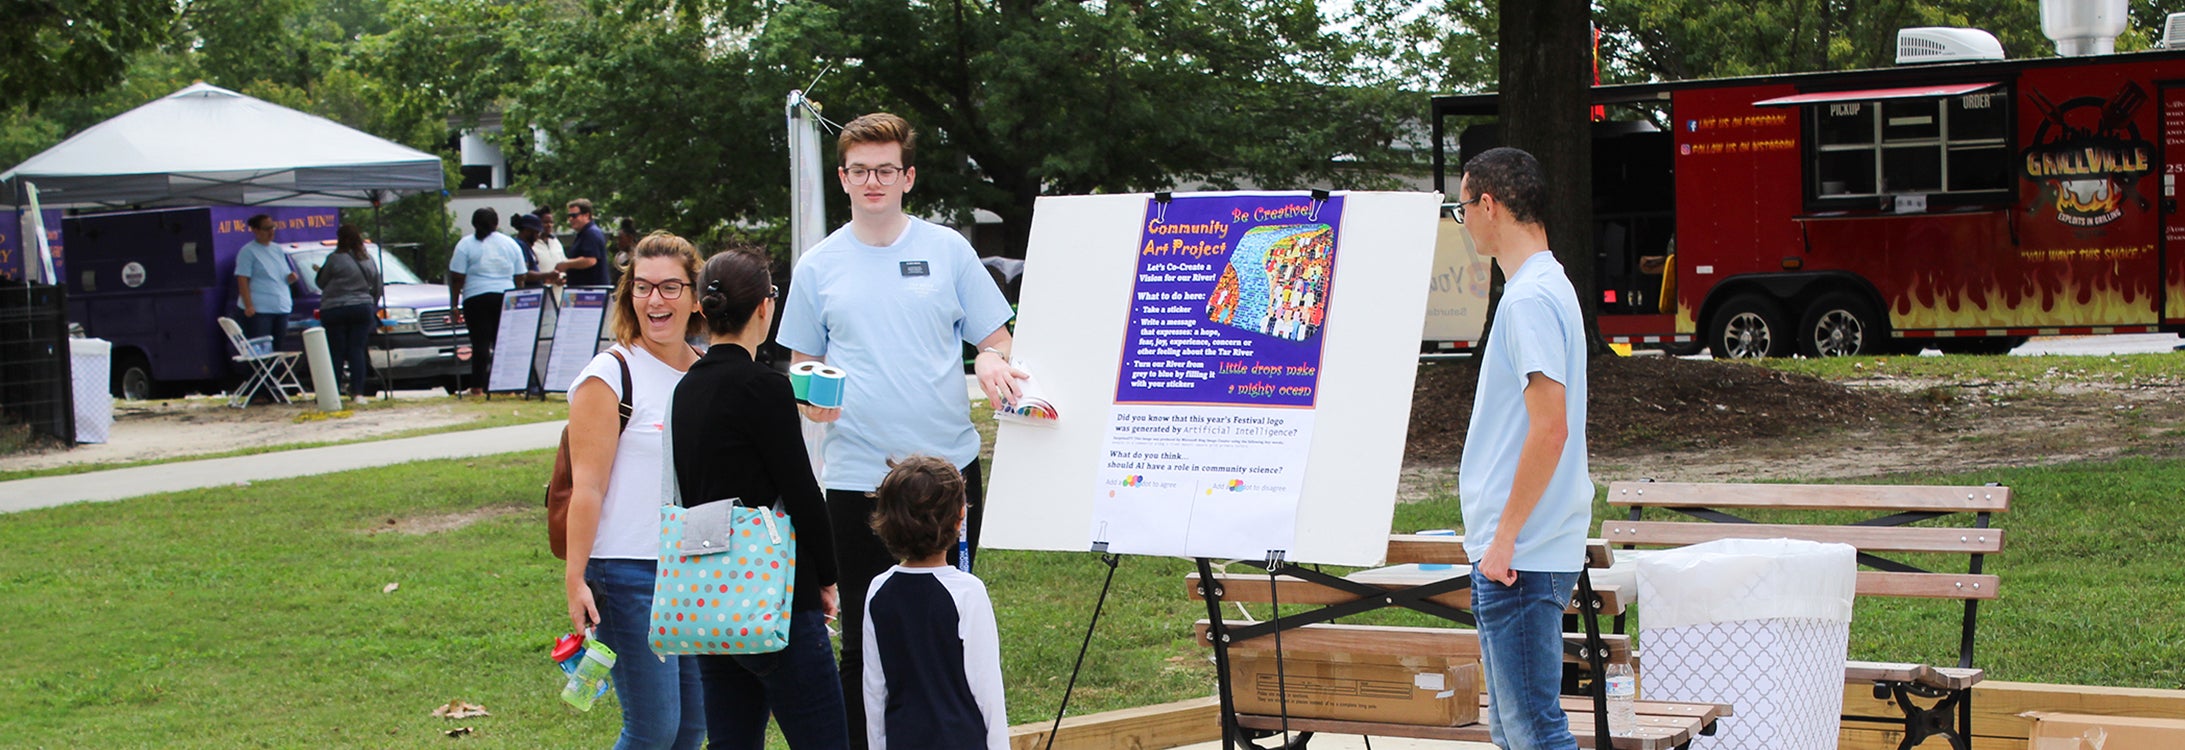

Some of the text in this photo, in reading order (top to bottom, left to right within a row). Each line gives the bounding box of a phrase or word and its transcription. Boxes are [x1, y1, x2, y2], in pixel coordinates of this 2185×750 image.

[1962, 94, 1991, 110] ORDER
[1830, 102, 1860, 117] PICKUP
[2026, 147, 2149, 176] GRILLVILLE
[1231, 201, 1313, 223] Be Creative!
[2057, 208, 2122, 226] EXPLOITS IN GRILLING
[218, 220, 231, 233] All
[233, 219, 246, 232] We
[289, 218, 305, 229] WIN
[1148, 218, 1229, 238] Community
[1143, 239, 1227, 259] Art Project
[2079, 248, 2100, 262] THIS
[1146, 262, 1165, 272] Let's
[1166, 262, 1205, 272] Co-Create
[1139, 273, 1163, 282] Vision
[1164, 273, 1176, 282] for
[1192, 273, 1216, 282] River!
[1137, 291, 1206, 300] What to do here:
[1142, 305, 1160, 313] Take
[1141, 318, 1160, 326] Write
[1167, 319, 1196, 327] message
[1141, 328, 1155, 336] that
[1156, 329, 1192, 337] expresses:
[1200, 328, 1220, 337] hope,
[1139, 338, 1154, 348] fear,
[1155, 338, 1168, 348] joy,
[1169, 338, 1210, 347] experience,
[1137, 348, 1156, 356] other
[1157, 348, 1181, 357] feeling
[1182, 348, 1204, 356] about
[1232, 349, 1254, 357] River
[1133, 360, 1151, 368] Turn
[1165, 360, 1185, 368] River
[1219, 360, 1316, 378] Little drops make
[1131, 371, 1147, 380] grey
[1175, 371, 1184, 380] by
[1185, 370, 1208, 380] filling
[1228, 380, 1312, 398] a mighty ocean
[1117, 413, 1284, 426] Did you know that this year's Festival logo
[1132, 424, 1170, 434] generated
[1172, 424, 1182, 435] by
[1183, 425, 1231, 435] Artificial
[1235, 426, 1298, 437] Intelligence?
[1109, 450, 1131, 458] What
[1132, 450, 1143, 458] do
[1144, 452, 1159, 460] you
[1107, 461, 1134, 469] should
[1146, 462, 1166, 470] have
[1174, 463, 1189, 471] role
[1191, 463, 1200, 471] in
[1201, 464, 1246, 474] community
[1249, 465, 1283, 474] science?
